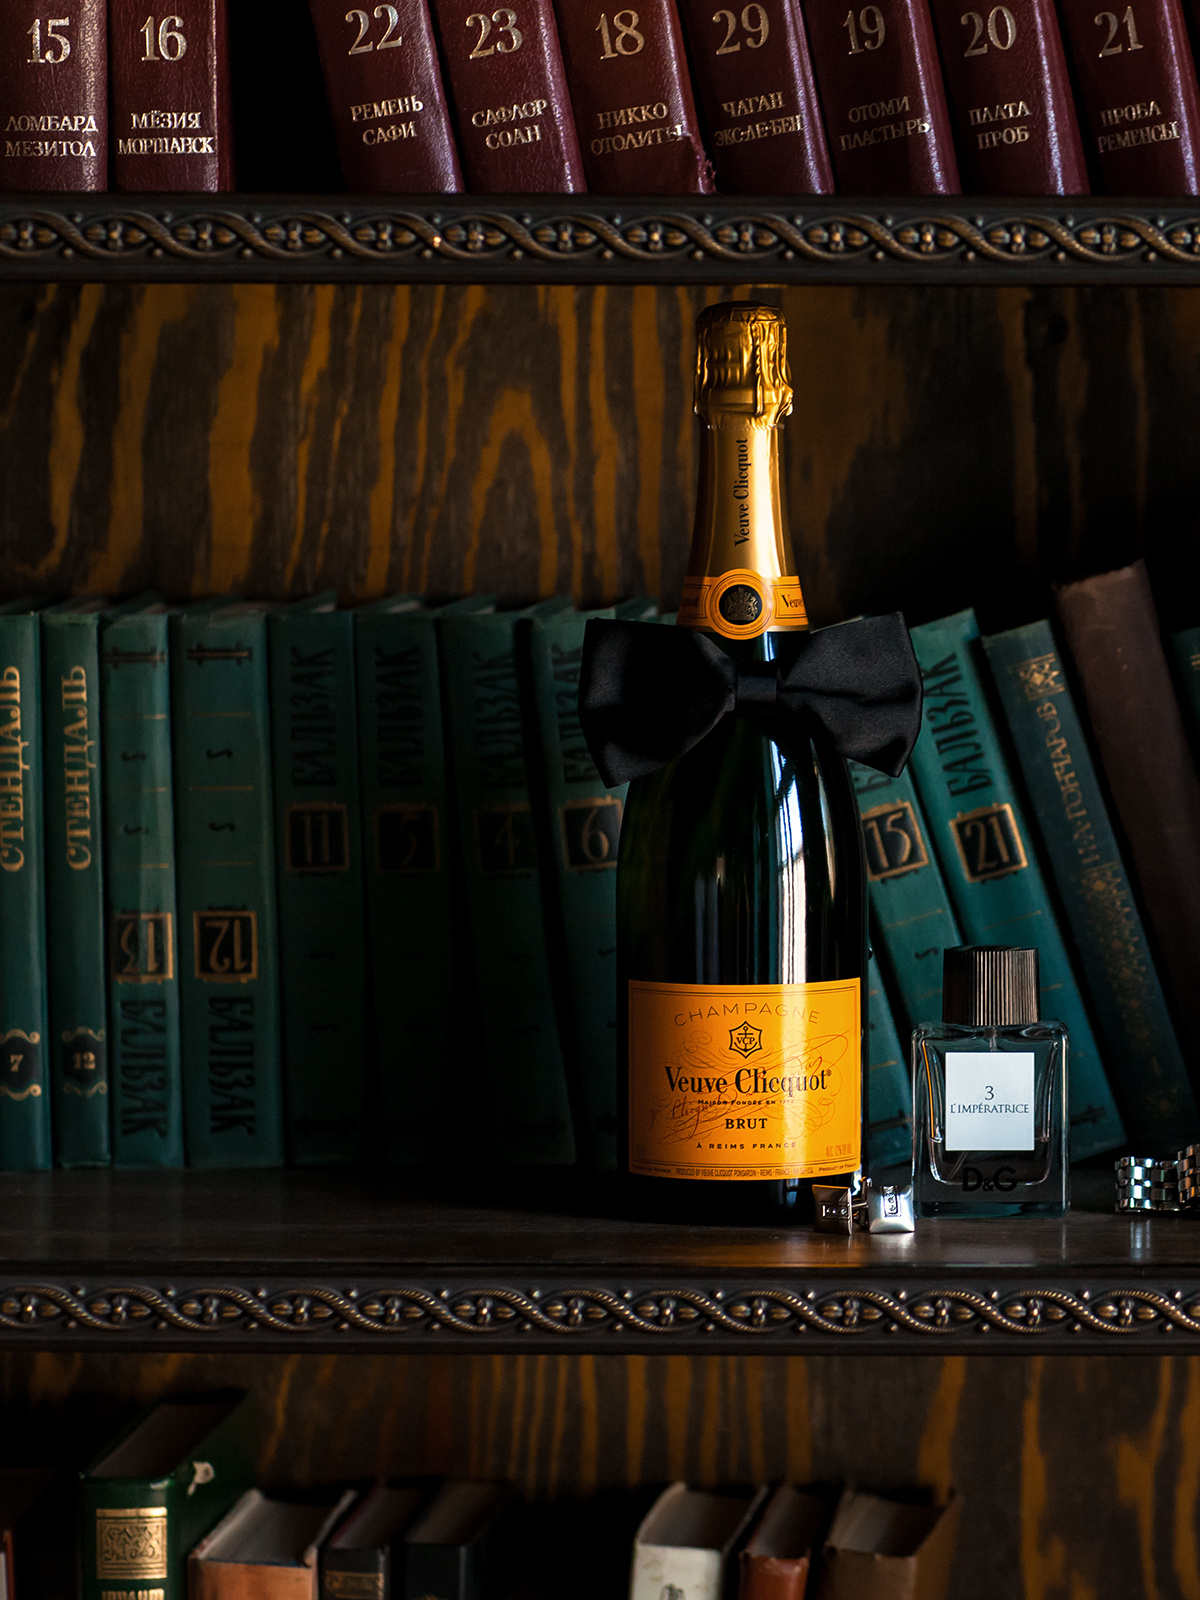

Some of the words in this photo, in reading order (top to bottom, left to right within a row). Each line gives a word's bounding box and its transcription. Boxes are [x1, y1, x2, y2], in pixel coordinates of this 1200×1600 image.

[27, 16, 71, 63] 15
[140, 15, 188, 62] 16
[345, 4, 403, 56] 22
[465, 8, 524, 60] 23
[595, 9, 645, 60] 18
[712, 3, 770, 56] 29
[841, 5, 886, 55] 19
[960, 5, 1018, 58] 20
[1094, 6, 1144, 58] 21
[4, 115, 99, 133] ЛОМБАРД
[130, 110, 202, 129] МЁЗИЯ
[350, 95, 424, 123] РЕМЕНЬ
[471, 99, 548, 128] САФЛОР
[597, 102, 669, 130] НИККО
[721, 91, 785, 118] ЧАГАН
[847, 96, 910, 123] ОТОМИ
[968, 100, 1032, 126] ПЛАТА
[1100, 100, 1162, 127] ПРОБА
[4, 140, 97, 157] МЕЗИТОЛ
[362, 121, 418, 146] САФИ
[484, 125, 542, 150] СОАН
[590, 124, 684, 155] ОТОЛИТЫ
[839, 117, 931, 151] ПЛАСТЫРЬ
[977, 126, 1030, 150] ПРОБ
[1097, 121, 1181, 153] РЕМЕНСЫ
[733, 438, 753, 501] Clicquot
[734, 503, 751, 548] Veuve
[290, 645, 337, 787] БАЛЬЗАК
[374, 645, 424, 787] БАЛЬЗАК
[472, 650, 528, 791] БАЛЬЗАК
[922, 652, 994, 798] БАЛЬЗАК
[0, 665, 30, 872] СТЕНДАЛЬ
[62, 665, 97, 871] СТЕНДАЛЬ
[303, 812, 331, 865] 11
[399, 814, 420, 868] 5
[493, 813, 516, 868] 4
[582, 807, 610, 863] 6
[865, 811, 912, 868] 15
[965, 815, 1011, 873] 21
[120, 920, 160, 973] 13
[204, 918, 248, 974] 12
[673, 1002, 820, 1027] CHAMPAGNE
[10, 1054, 24, 1073] 7
[73, 1051, 96, 1071] 12
[736, 1036, 756, 1046] VCP
[120, 999, 168, 1139] БАЛЬЗАК
[207, 996, 256, 1135] БАЛЬЗАК
[664, 1066, 727, 1094] Veuve
[984, 1086, 995, 1101] 3
[696, 1141, 703, 1150] À
[725, 1118, 768, 1129] BRUT
[962, 1166, 1017, 1192] D&G
